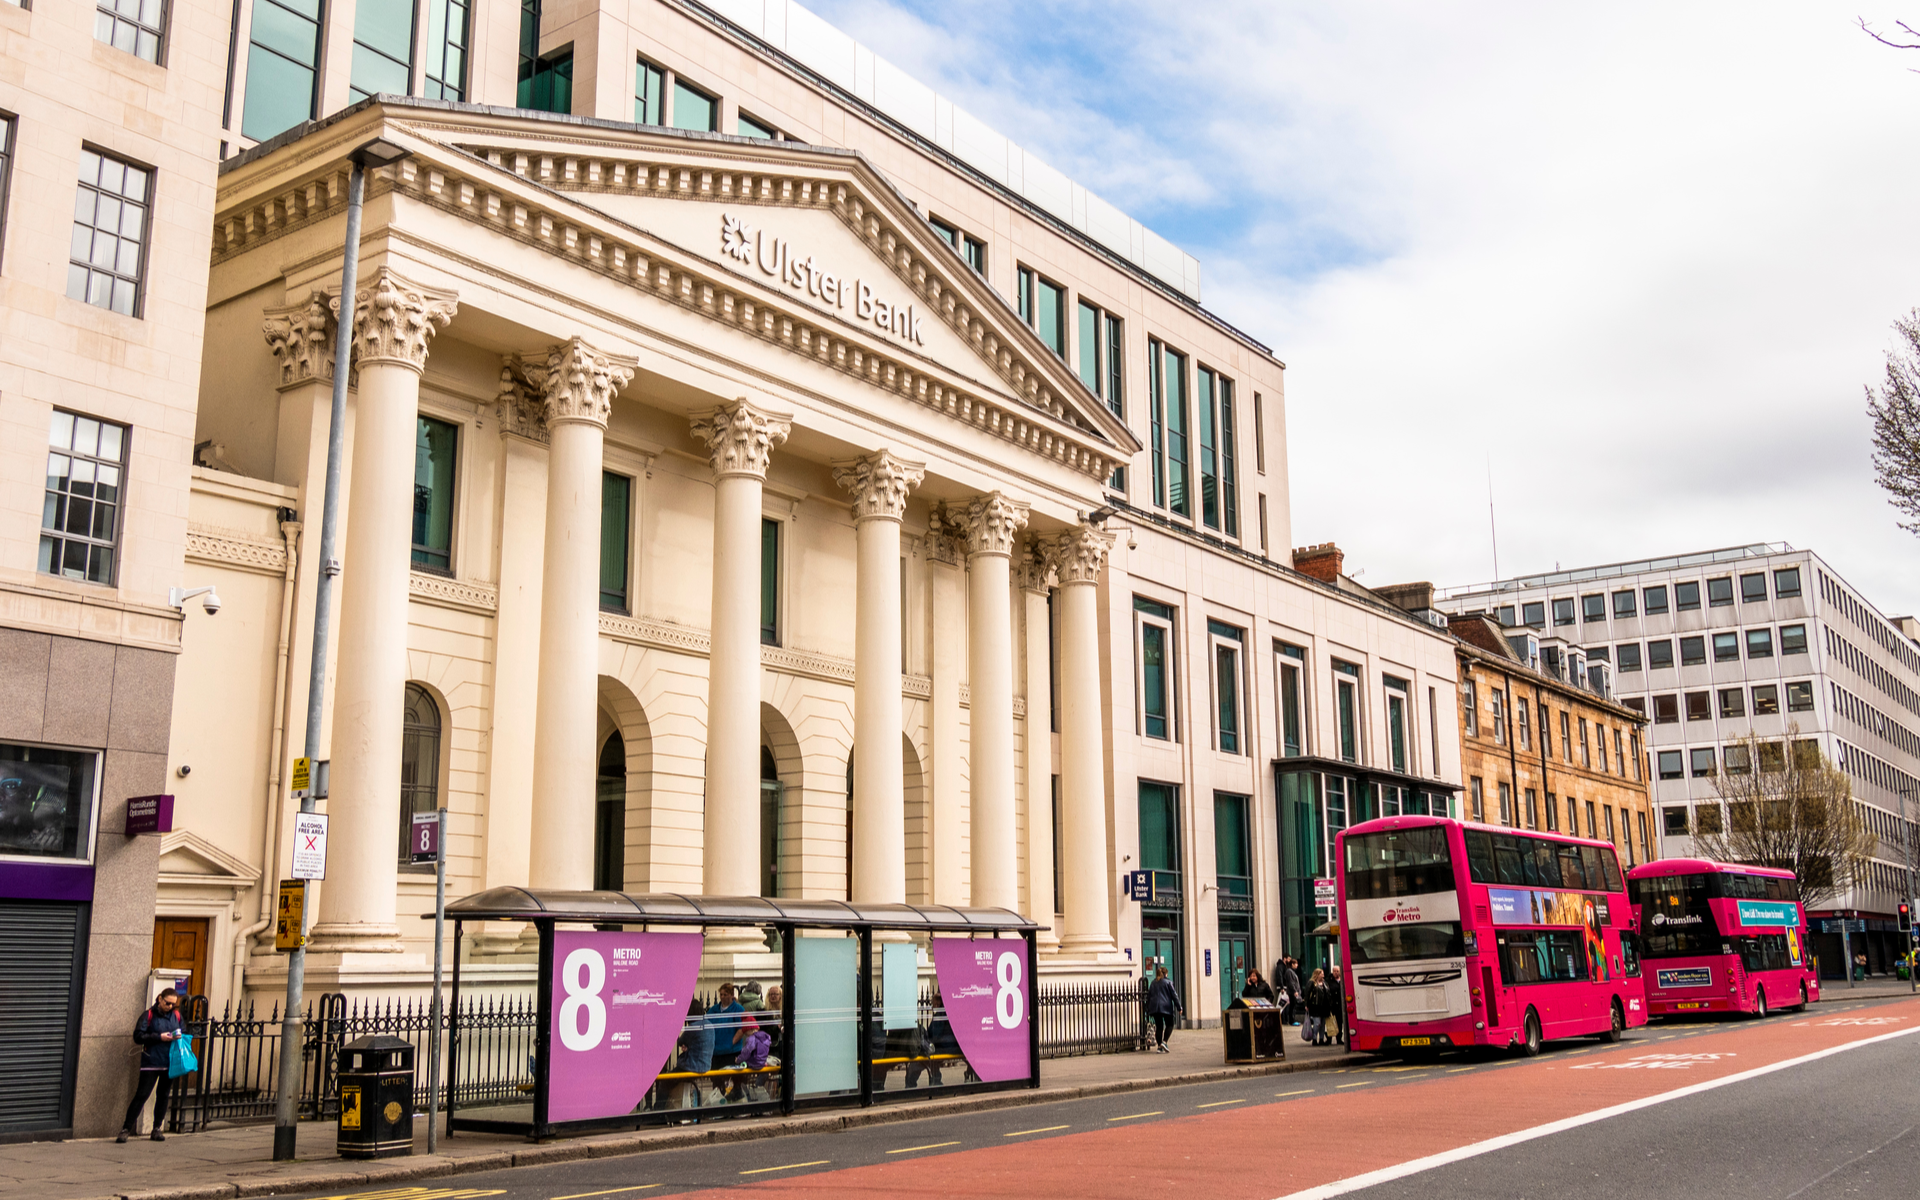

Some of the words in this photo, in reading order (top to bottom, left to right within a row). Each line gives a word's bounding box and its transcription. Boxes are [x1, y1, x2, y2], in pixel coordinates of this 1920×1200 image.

[757, 228, 850, 309] Ulster
[856, 277, 925, 346] Bank
[420, 829, 430, 851] 8
[1670, 896, 1679, 906] 9a
[1397, 913, 1421, 921] Metro
[1665, 914, 1702, 925] Translink
[301, 936, 305, 945] 3
[613, 948, 641, 959] METRO
[975, 951, 992, 960] METRO
[996, 951, 1024, 1029] 8
[559, 948, 606, 1052] 8
[1568, 1061, 1715, 1069] LANE
[382, 1078, 405, 1086] LITTER
